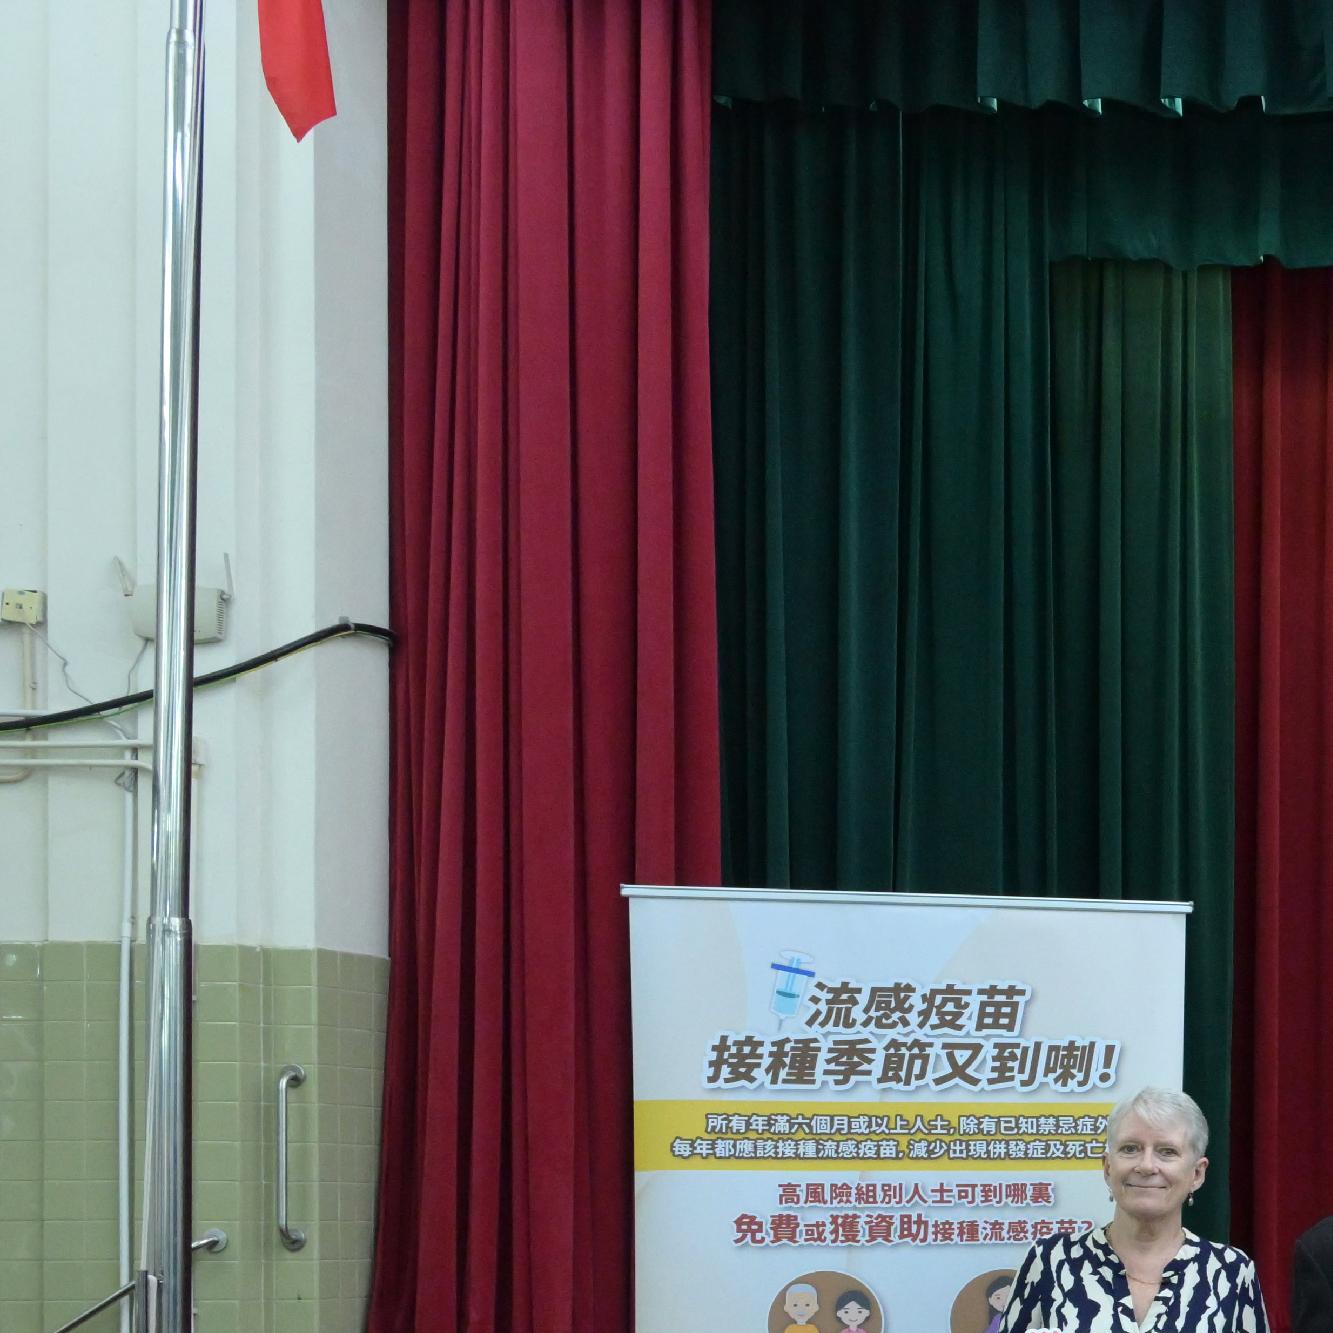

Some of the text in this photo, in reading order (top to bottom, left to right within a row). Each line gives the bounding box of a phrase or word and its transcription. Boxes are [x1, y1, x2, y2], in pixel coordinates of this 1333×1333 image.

[805, 981, 1027, 1032] 流感疫苗
[706, 1036, 1118, 1088] 接種季節又到喇!
[777, 1181, 1054, 1206] 高風險組別人士可到哪裏
